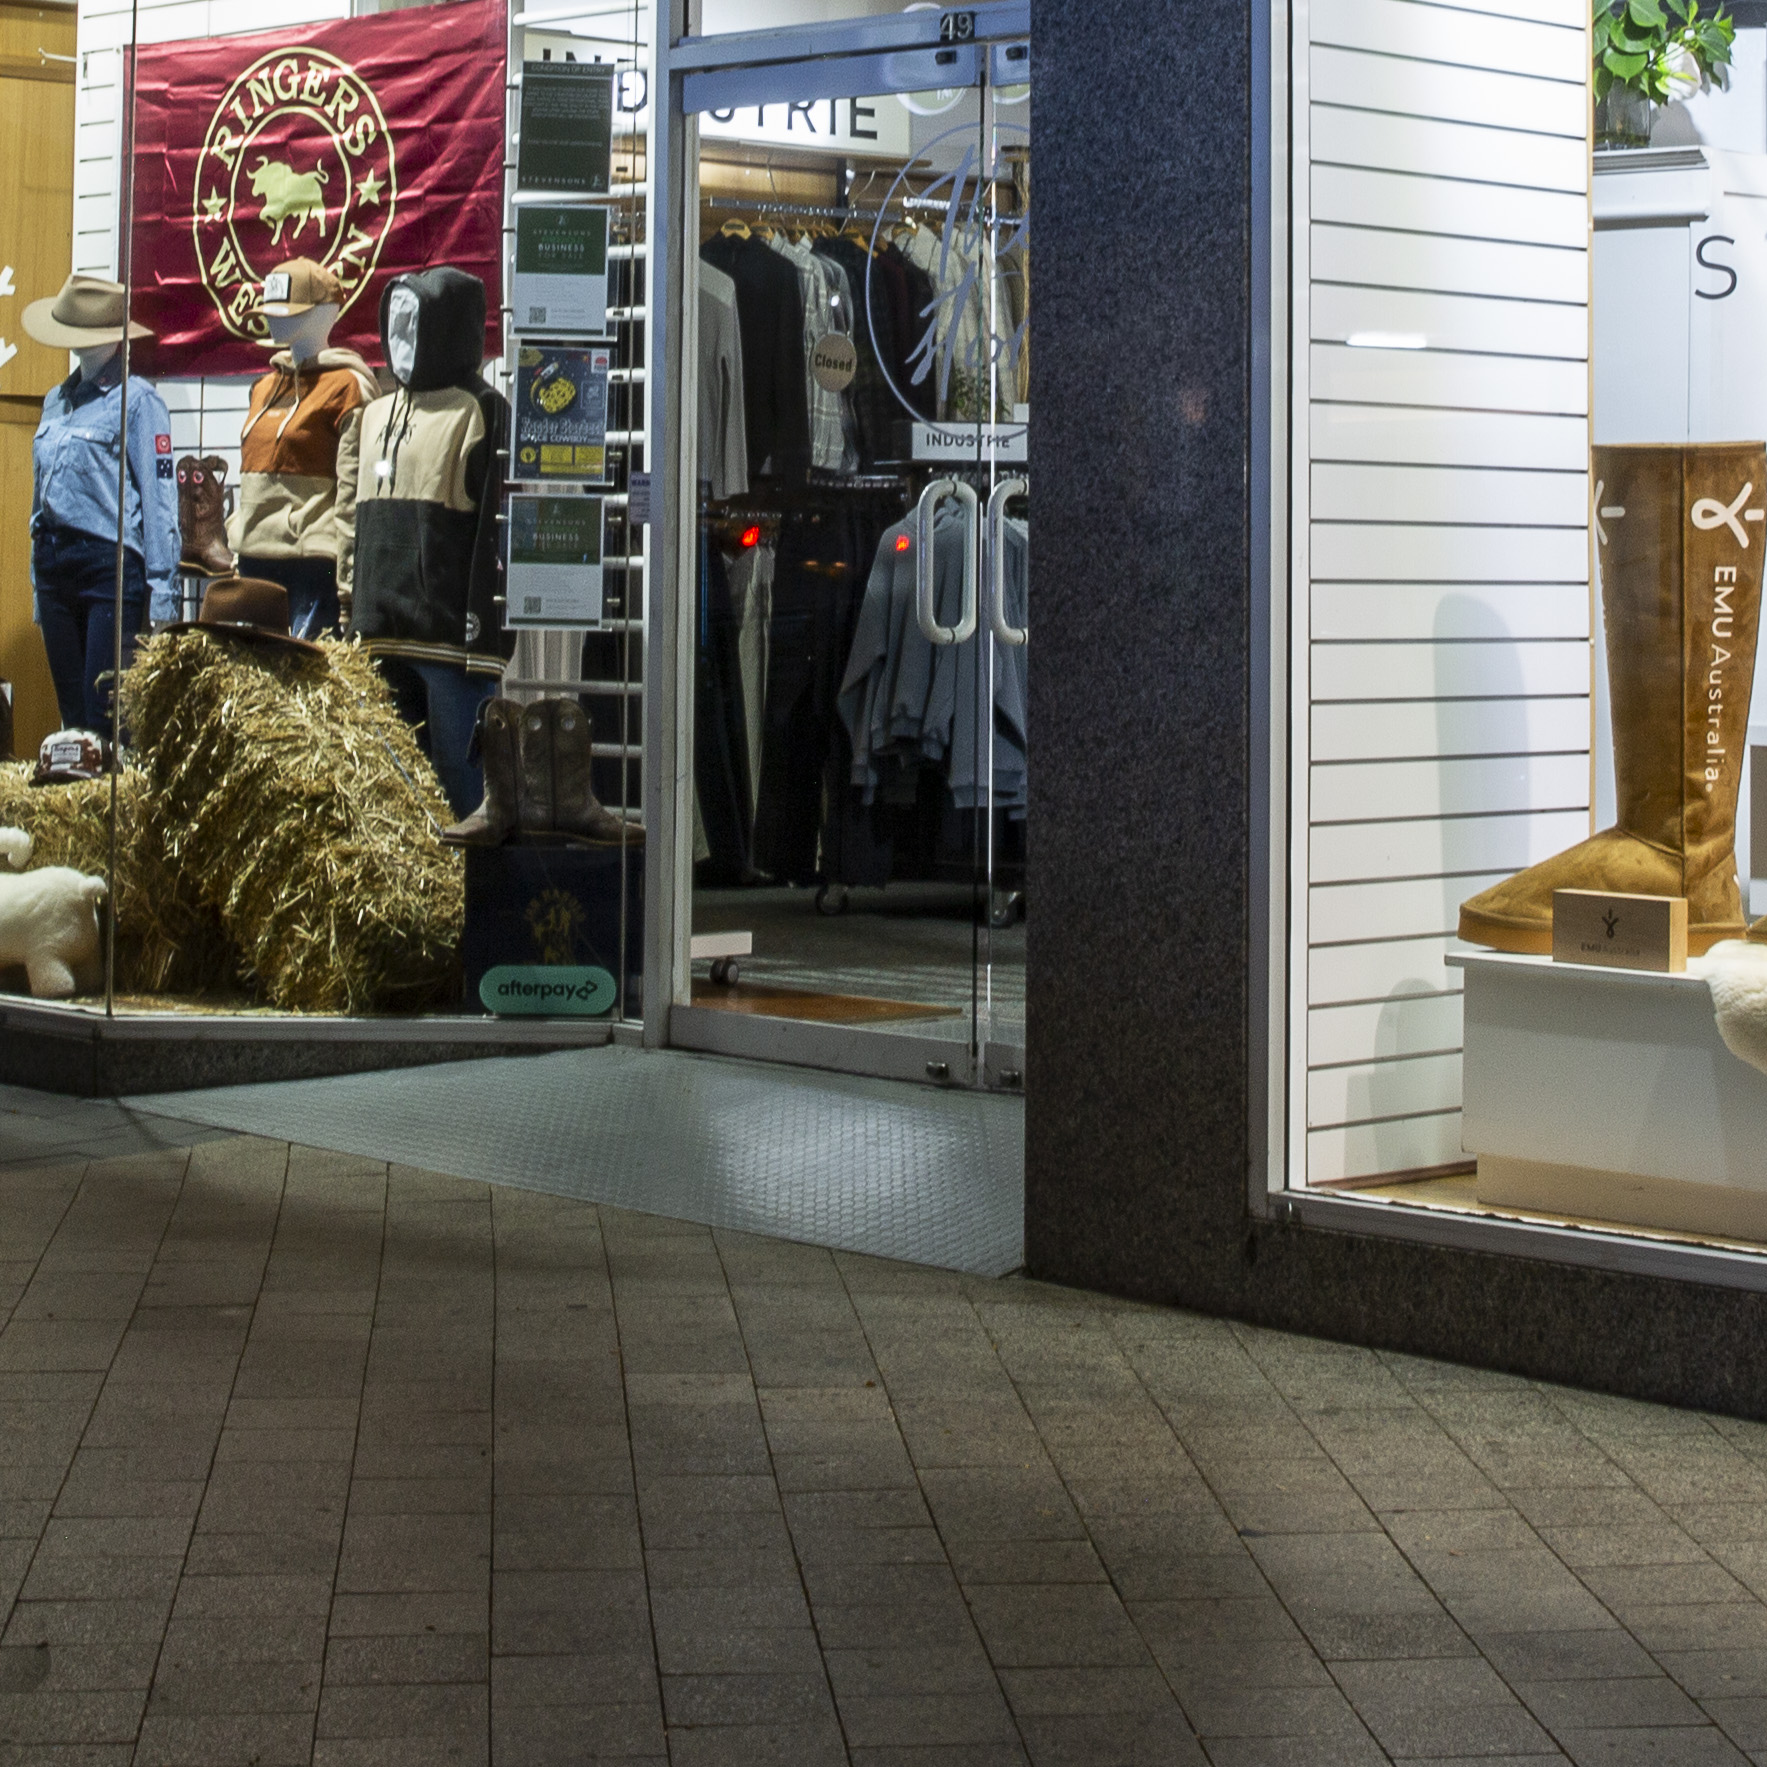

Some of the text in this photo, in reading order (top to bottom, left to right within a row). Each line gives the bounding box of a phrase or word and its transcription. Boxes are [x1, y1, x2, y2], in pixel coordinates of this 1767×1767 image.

[940, 14, 973, 40] 49
[210, 59, 377, 170] RINGERS
[538, 243, 585, 253] BUSINESS
[815, 352, 853, 372] Closed
[1712, 565, 1737, 638] EMU
[497, 979, 577, 1001] afterpay
